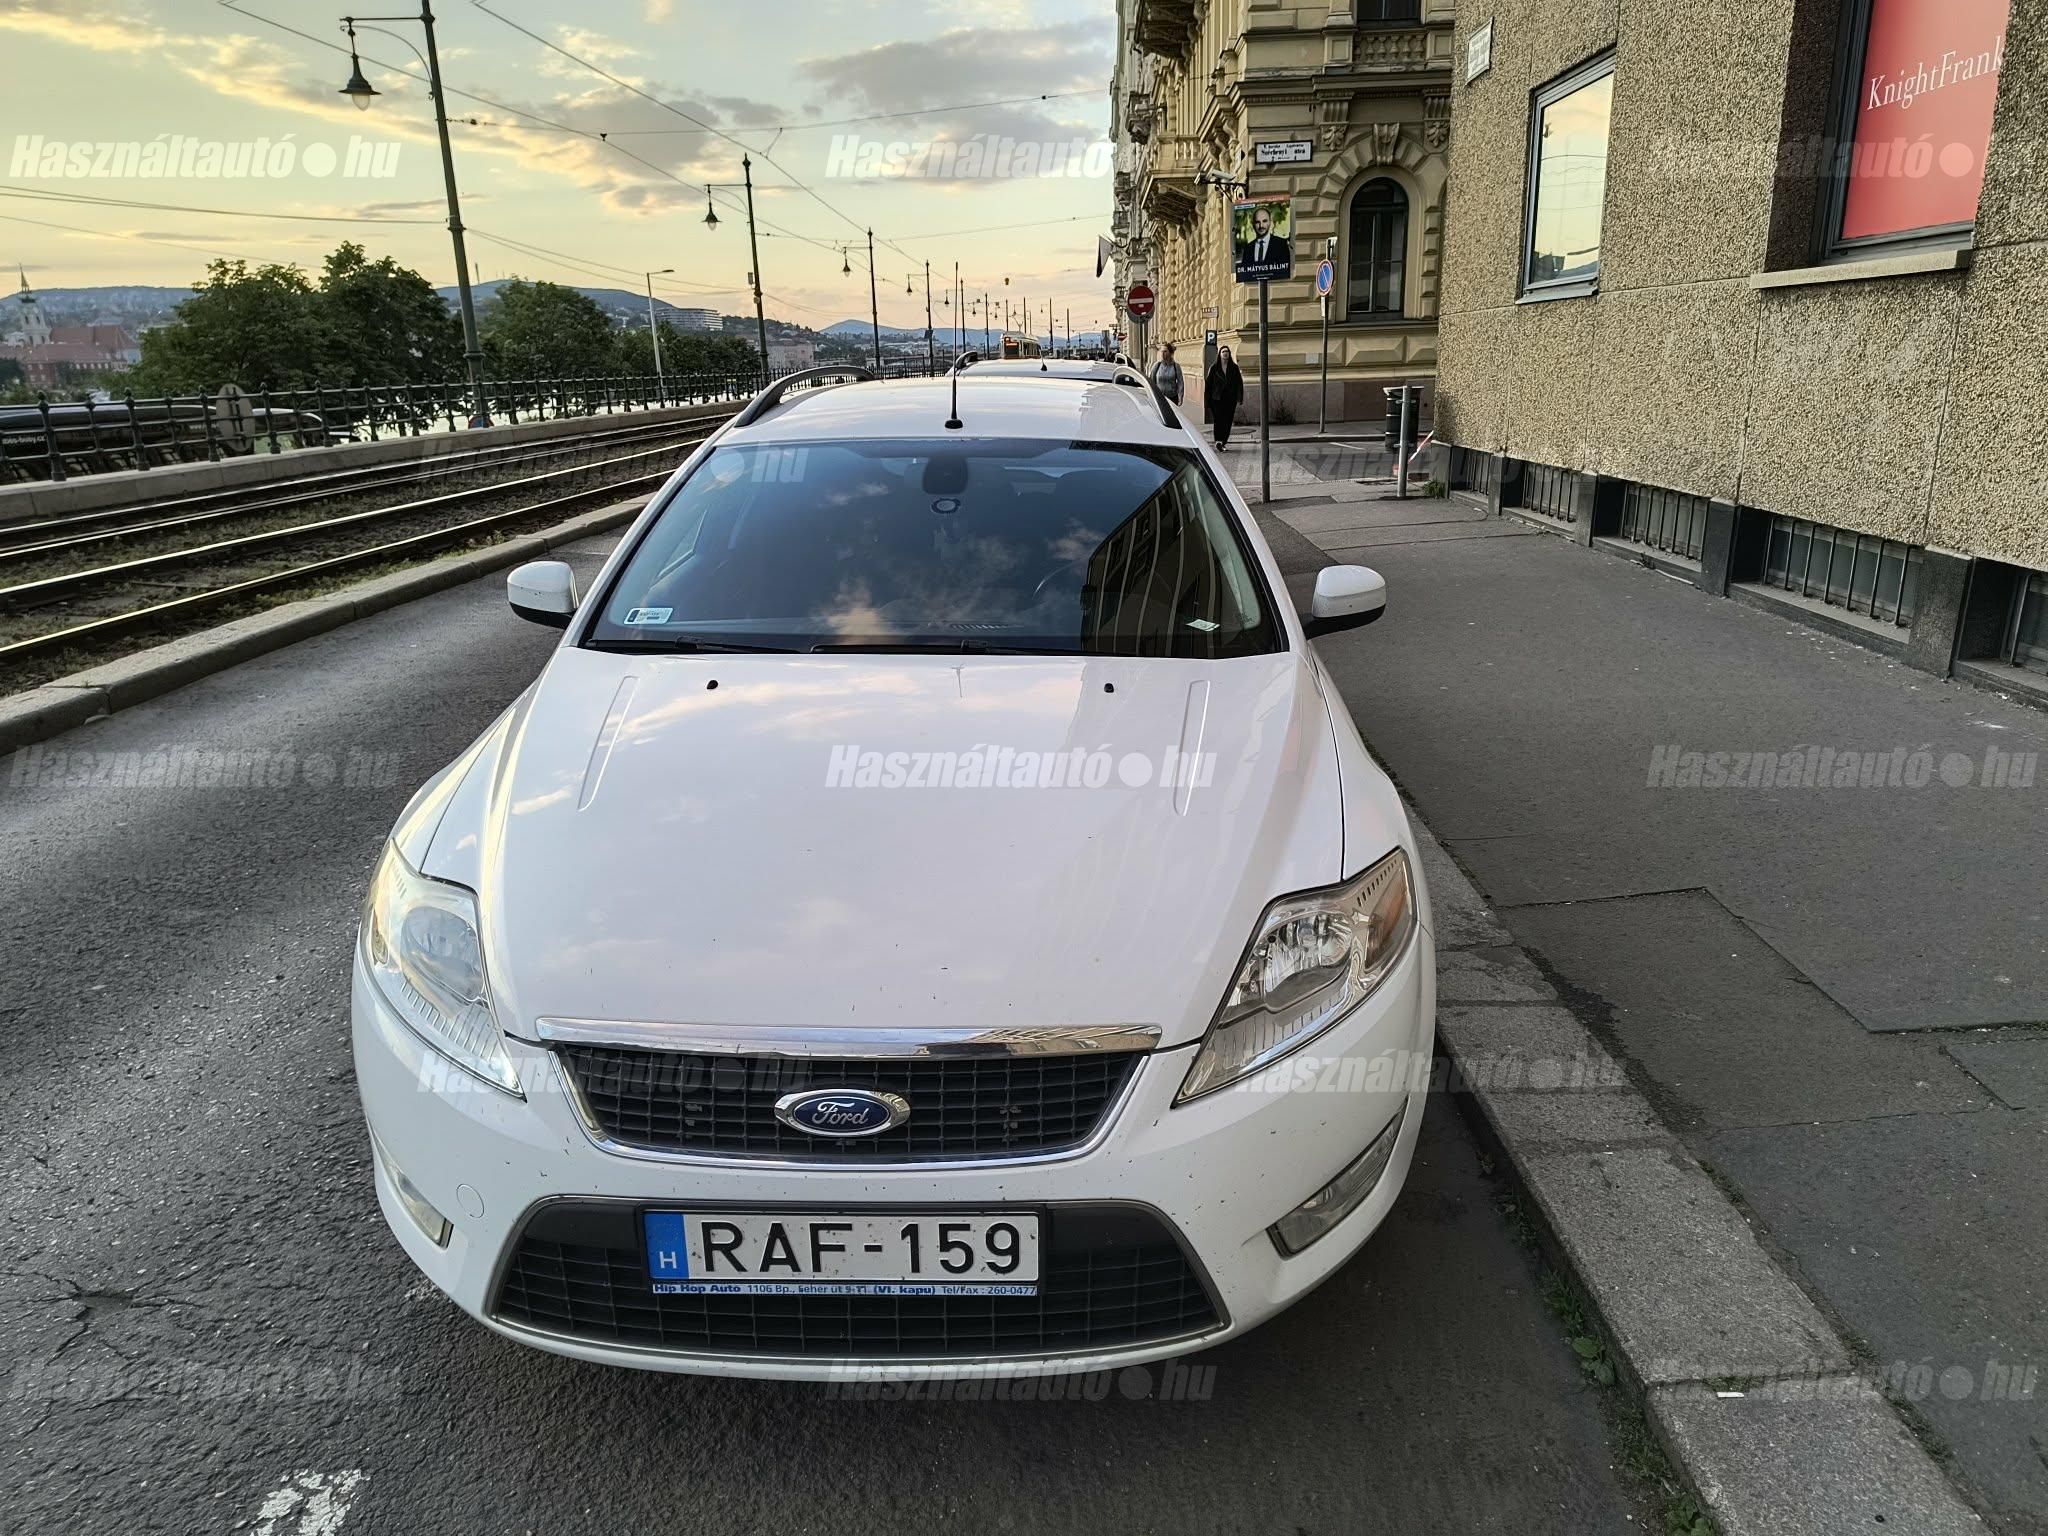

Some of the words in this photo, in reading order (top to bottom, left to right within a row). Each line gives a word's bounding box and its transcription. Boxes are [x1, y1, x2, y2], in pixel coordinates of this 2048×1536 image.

[812, 1101, 869, 1125] Ford
[701, 1220, 1021, 1275] RAF-159
[659, 1251, 677, 1269] H
[655, 1284, 677, 1294] Hip
[680, 1284, 706, 1294] Hop
[710, 1284, 741, 1293] Auto
[899, 1285, 936, 1295] kapu)
